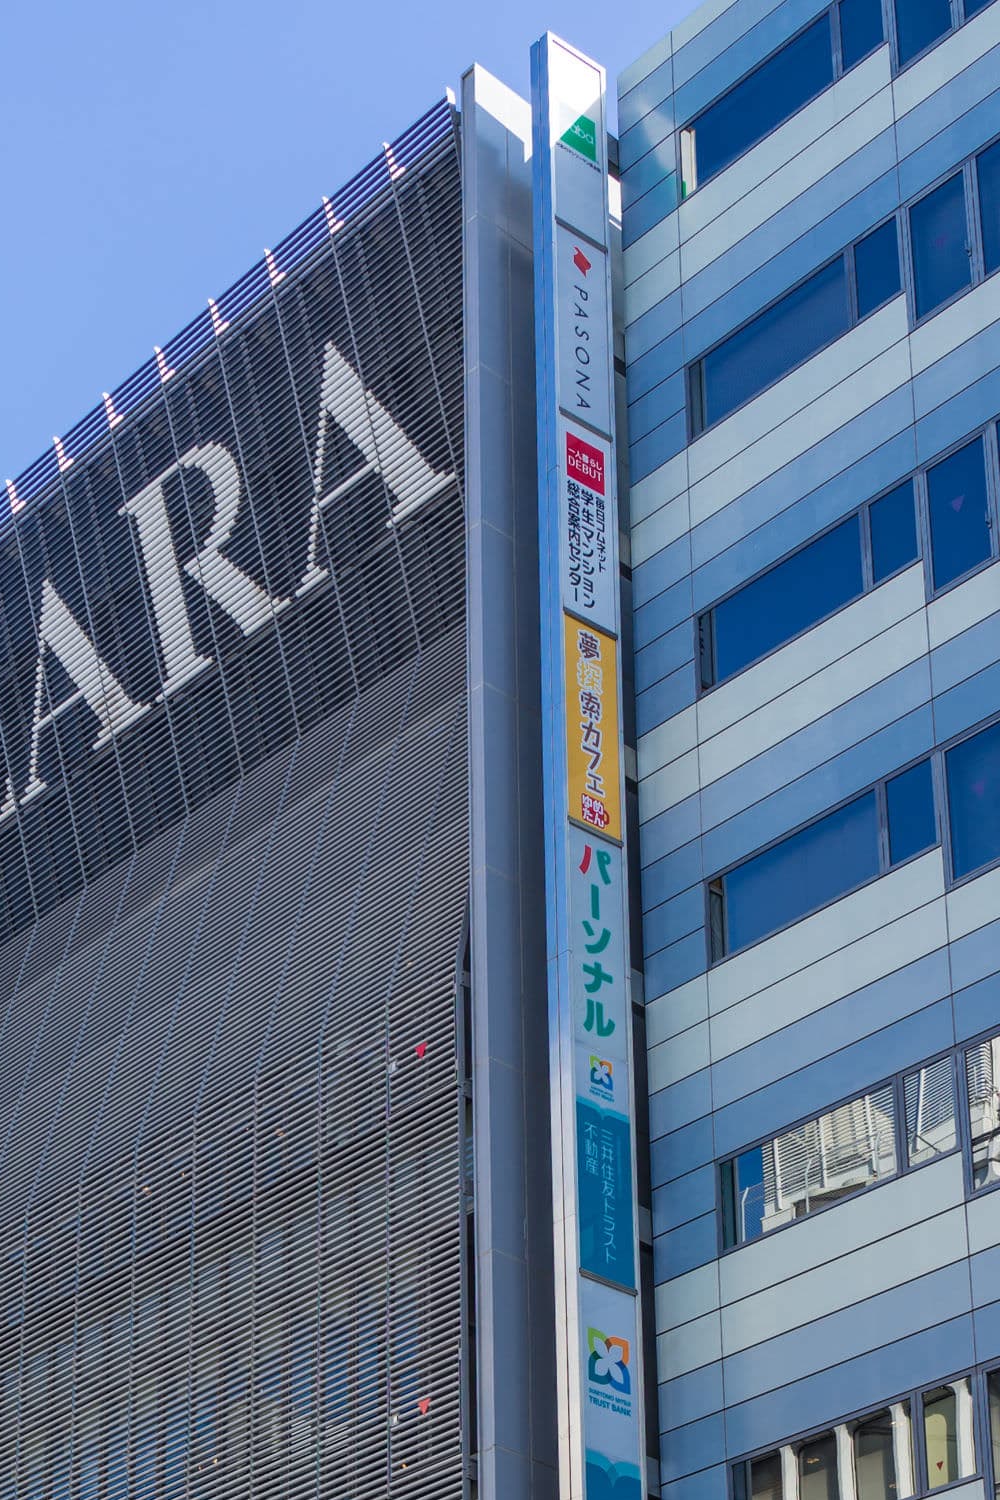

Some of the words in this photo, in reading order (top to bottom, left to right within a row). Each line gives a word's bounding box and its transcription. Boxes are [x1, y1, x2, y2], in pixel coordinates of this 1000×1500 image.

[573, 284, 592, 409] PASONA
[567, 447, 603, 471] 一人暮らし
[568, 455, 603, 482] DEBUT
[567, 479, 582, 603] 総合案内センター
[580, 488, 596, 609] 学生マンション
[579, 844, 616, 1038] パーソナル
[584, 1121, 599, 1176] 不動産
[601, 1128, 617, 1264] 三井住友トラスト
[589, 1394, 610, 1409] TRUST
[611, 1403, 632, 1417] BANK
